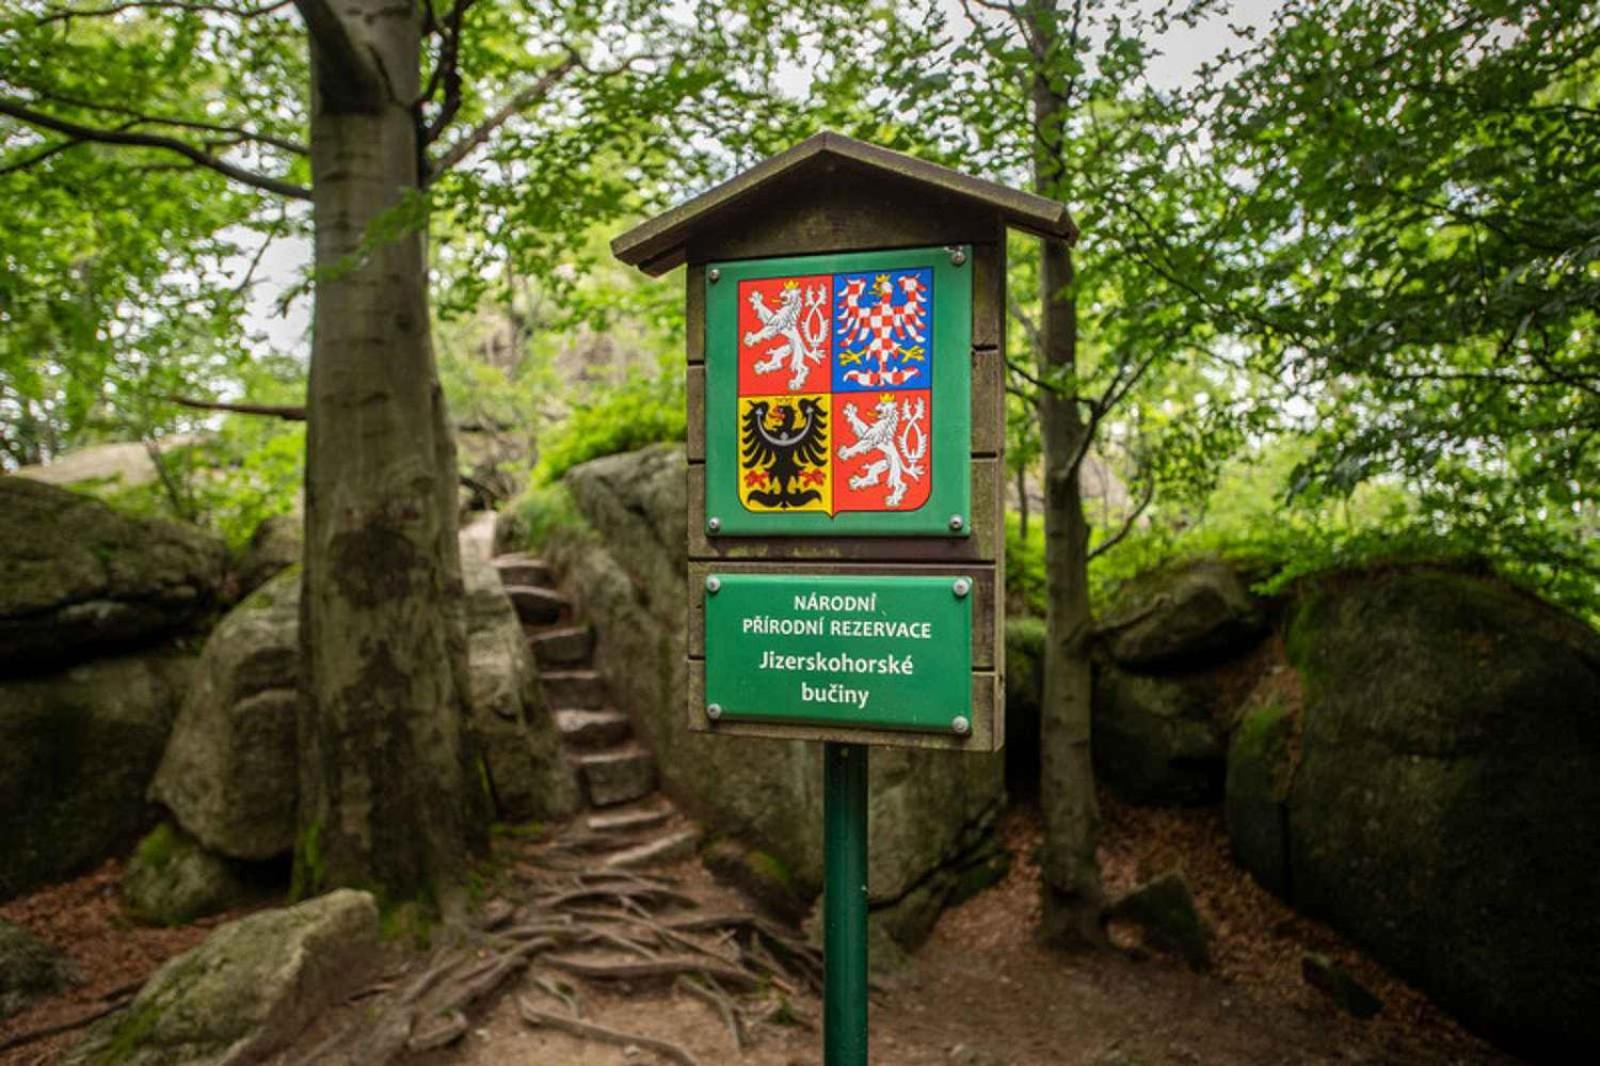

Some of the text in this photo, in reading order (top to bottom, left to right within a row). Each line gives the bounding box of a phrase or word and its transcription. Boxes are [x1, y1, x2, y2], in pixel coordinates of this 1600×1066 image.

[794, 592, 877, 612] NÁRODNÍ
[743, 615, 932, 639] PŘÍRODNÍ REZERVACE
[759, 651, 913, 675] Jizerskohorské
[801, 682, 869, 709] bučiny
